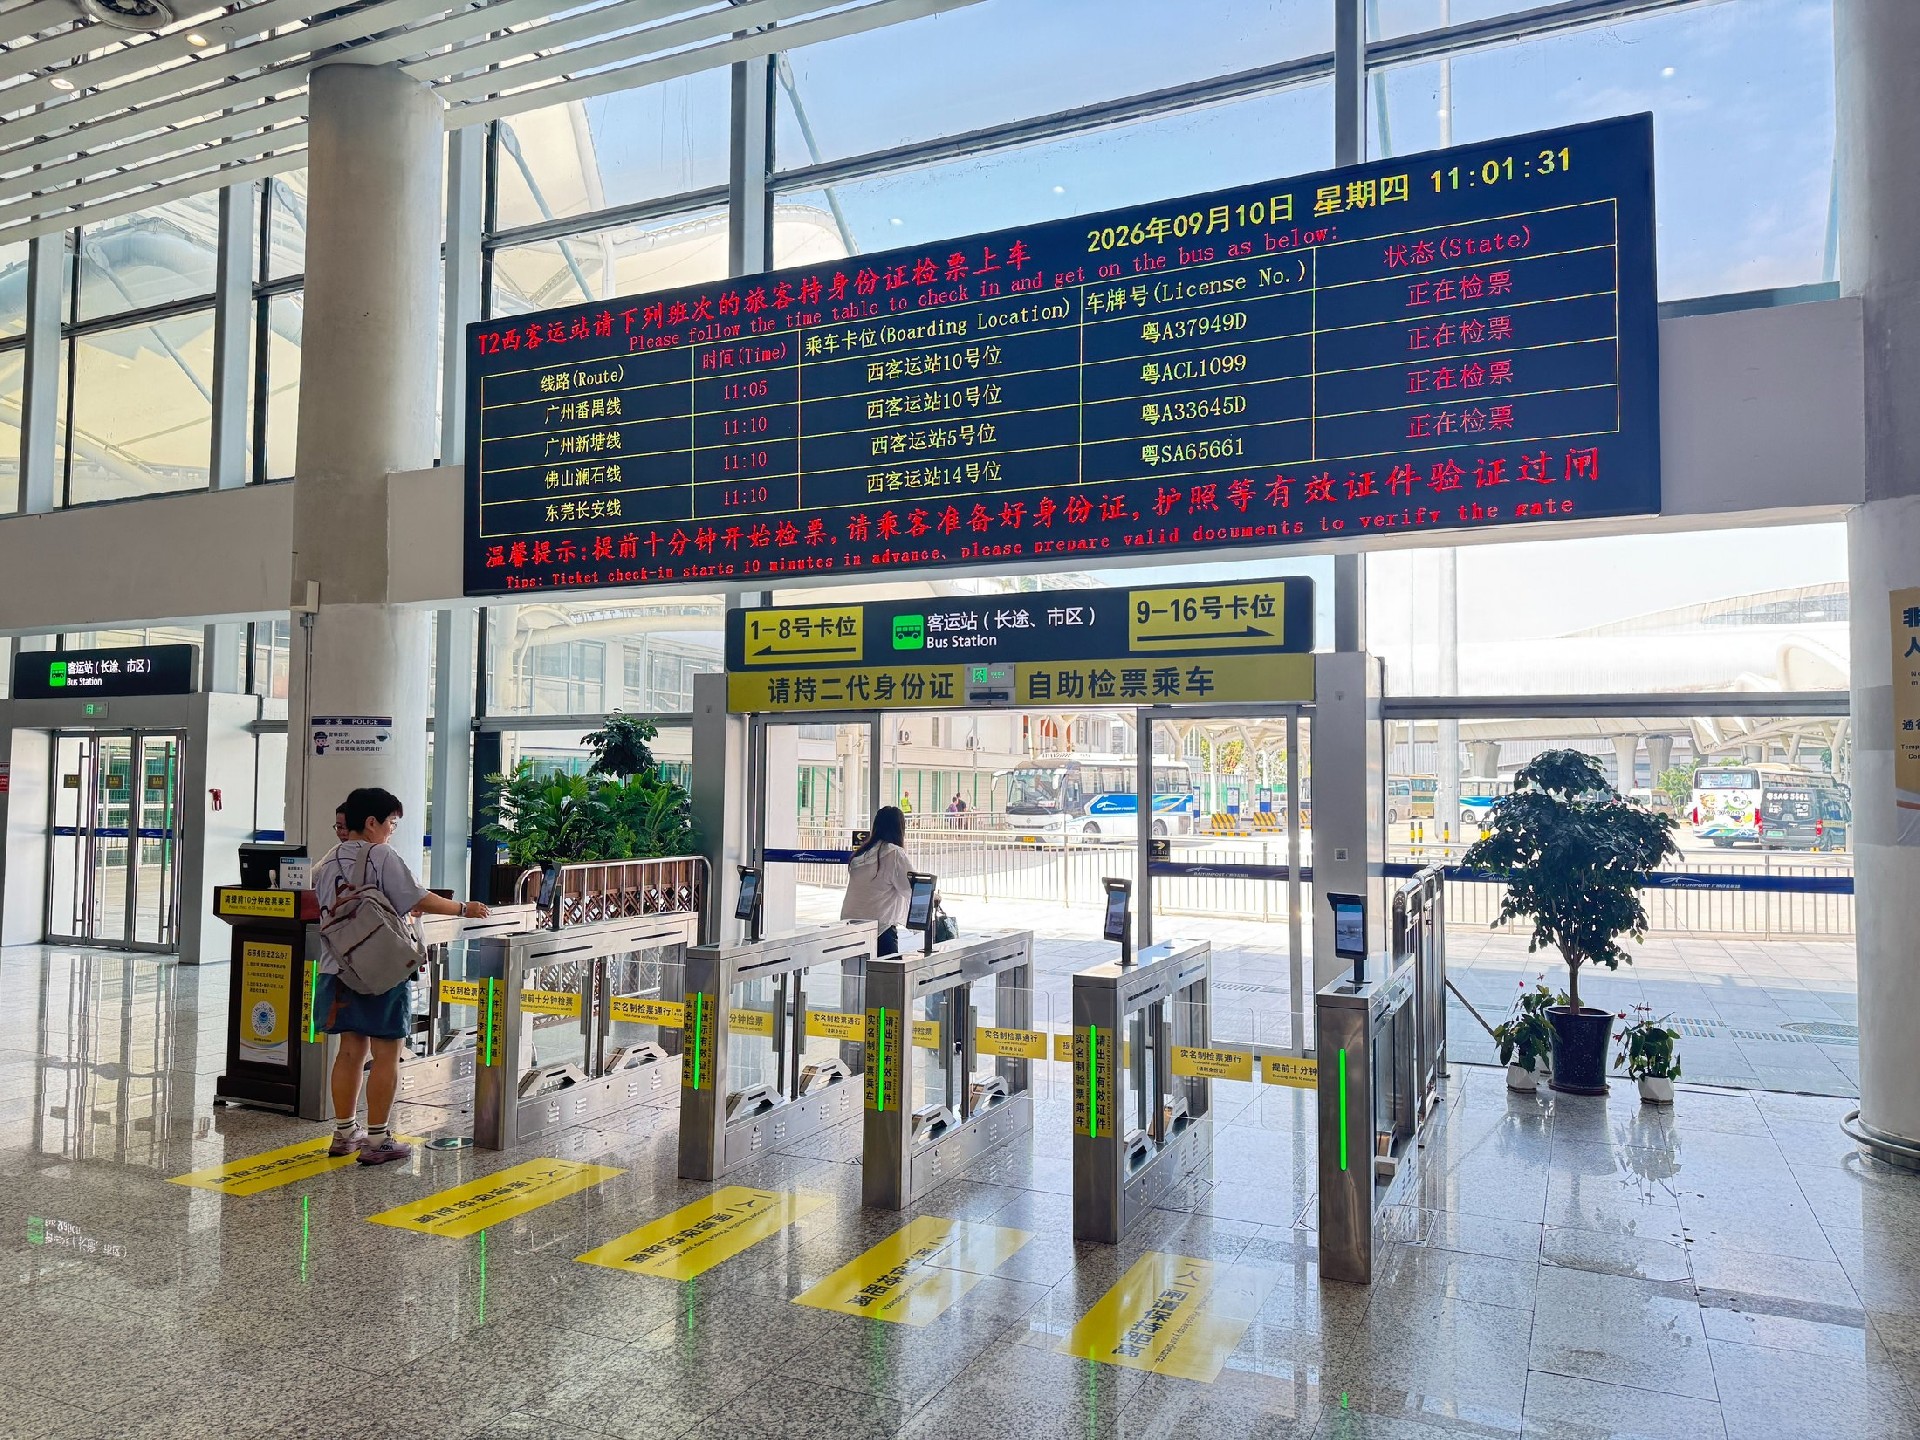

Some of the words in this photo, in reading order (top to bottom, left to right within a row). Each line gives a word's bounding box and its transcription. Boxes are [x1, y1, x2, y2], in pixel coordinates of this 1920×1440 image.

[1088, 194, 1293, 253] 2026年09月10日
[1313, 172, 1409, 218] 星期四
[1430, 147, 1570, 193] 11:01:31
[1383, 226, 1532, 268] 状态(State)
[479, 239, 1031, 356] T2西客运站请下列班次的旅客持身份证检票上车
[629, 334, 679, 352] Please
[688, 323, 741, 343] follow
[750, 316, 777, 334] the
[786, 310, 823, 328] time
[832, 301, 878, 323] table
[889, 296, 908, 312] to
[917, 286, 970, 306] check
[980, 280, 1001, 297] in
[1010, 274, 1044, 292] and
[1054, 265, 1086, 288] get
[1098, 261, 1122, 278] on
[1132, 252, 1167, 273] the
[1178, 245, 1214, 265] bus
[1227, 242, 1252, 258] as
[1264, 225, 1339, 251] below:
[1085, 275, 1246, 316] 车牌号(License
[1258, 260, 1307, 287] No.)
[1405, 270, 1513, 307] 正在检票
[804, 316, 967, 357] 乘车卡位(Boarding
[977, 301, 1071, 330] Location)
[1140, 312, 1247, 344] 粤A37949D
[1406, 315, 1513, 350] 正在检票
[702, 342, 787, 370] 时间(Time)
[867, 345, 1003, 382] 西客运站10号位
[1140, 354, 1247, 385] 粤ACL1099
[540, 364, 625, 393] 线路(Route)
[723, 382, 769, 401] 11:05
[1405, 360, 1514, 394] 正在检票
[544, 397, 622, 425] 广州番禺线
[867, 384, 1003, 420] 西客运站10号位
[1140, 396, 1247, 426] 粤A33645D
[723, 416, 769, 436] 11:10
[1405, 404, 1514, 438] 正在检票
[544, 432, 622, 458] 广州新塘线
[871, 423, 997, 456] 西客运站5号位
[1141, 438, 1244, 467] 粤SA65661
[544, 465, 622, 490] 佛山澜石线
[723, 452, 769, 471] 11:10
[867, 460, 1003, 494] 西客运站14号位
[544, 499, 622, 523] 东莞长安线
[724, 487, 769, 506] 11:10
[552, 571, 599, 585] Ticket
[608, 566, 674, 582] check-in
[683, 563, 734, 577] starts
[743, 560, 760, 573] 10
[769, 556, 834, 572] minutes
[843, 553, 861, 566] in
[1124, 529, 1179, 546] valid
[1192, 520, 1305, 541] documents
[1319, 516, 1345, 531] to
[1360, 509, 1440, 529] verify
[1458, 503, 1498, 521] the
[926, 606, 1097, 633] 客运站（长途、市区）
[1136, 593, 1276, 625] 9-16号卡位
[750, 615, 857, 641] 1-8号卡位
[926, 636, 949, 649] Bus
[951, 634, 997, 648] Station
[66, 678, 78, 687] Bus
[79, 676, 103, 686] Station
[67, 658, 152, 675] 客运站（长途、市区）
[767, 672, 954, 705] 请持二代身份证
[1028, 666, 1215, 700] 自助检票乘车
[866, 1014, 876, 1101] 实名制验票乘车
[1180, 1049, 1242, 1063] 实名制检票通行
[1075, 1033, 1085, 1127] 实名制验票乘车
[1096, 1035, 1106, 1130] 请出示有效证件
[624, 1194, 773, 1265] 一人一闸请保持距离
[1111, 1263, 1213, 1359] 一人一闸请保持距离
